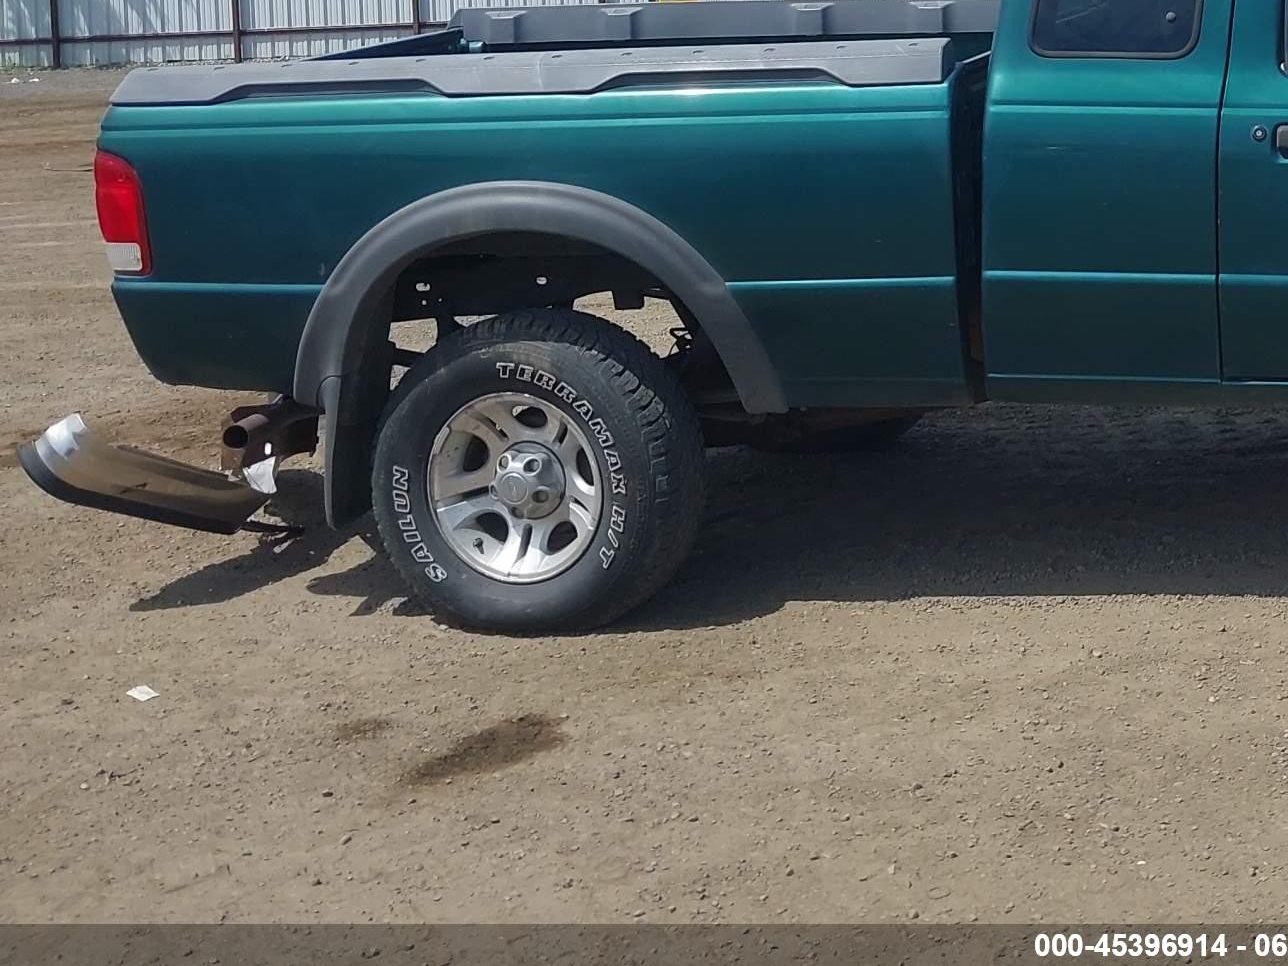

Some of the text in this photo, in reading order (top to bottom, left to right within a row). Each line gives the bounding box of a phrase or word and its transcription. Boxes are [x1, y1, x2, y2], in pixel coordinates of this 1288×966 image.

[393, 465, 447, 583] SAILUN
[496, 362, 627, 569] TERRAMAX H/T
